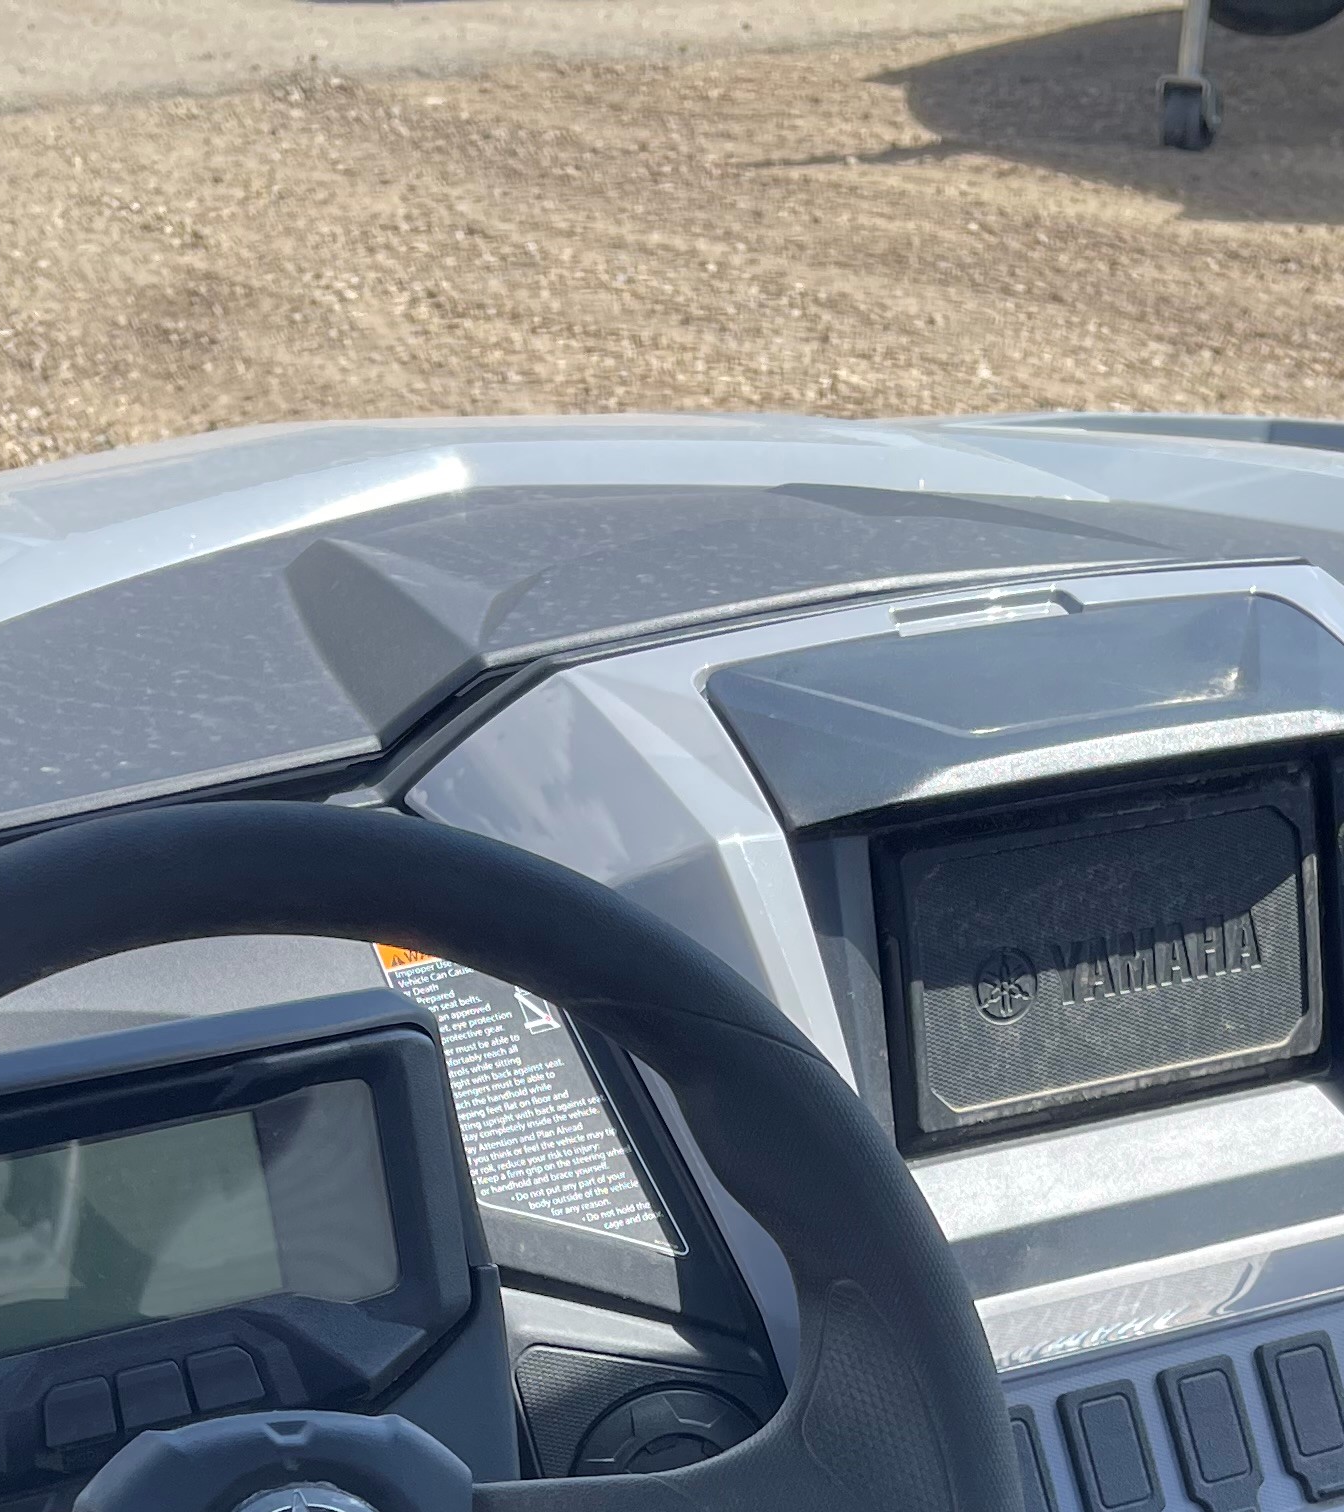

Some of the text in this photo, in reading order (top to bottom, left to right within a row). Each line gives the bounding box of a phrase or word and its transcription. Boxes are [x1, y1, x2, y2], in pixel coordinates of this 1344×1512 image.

[1050, 909, 1262, 1006] YAMAHA
[394, 961, 452, 978] Improper Use
[398, 976, 429, 988] Vehicle
[430, 972, 447, 981] Can
[412, 984, 439, 996] Death
